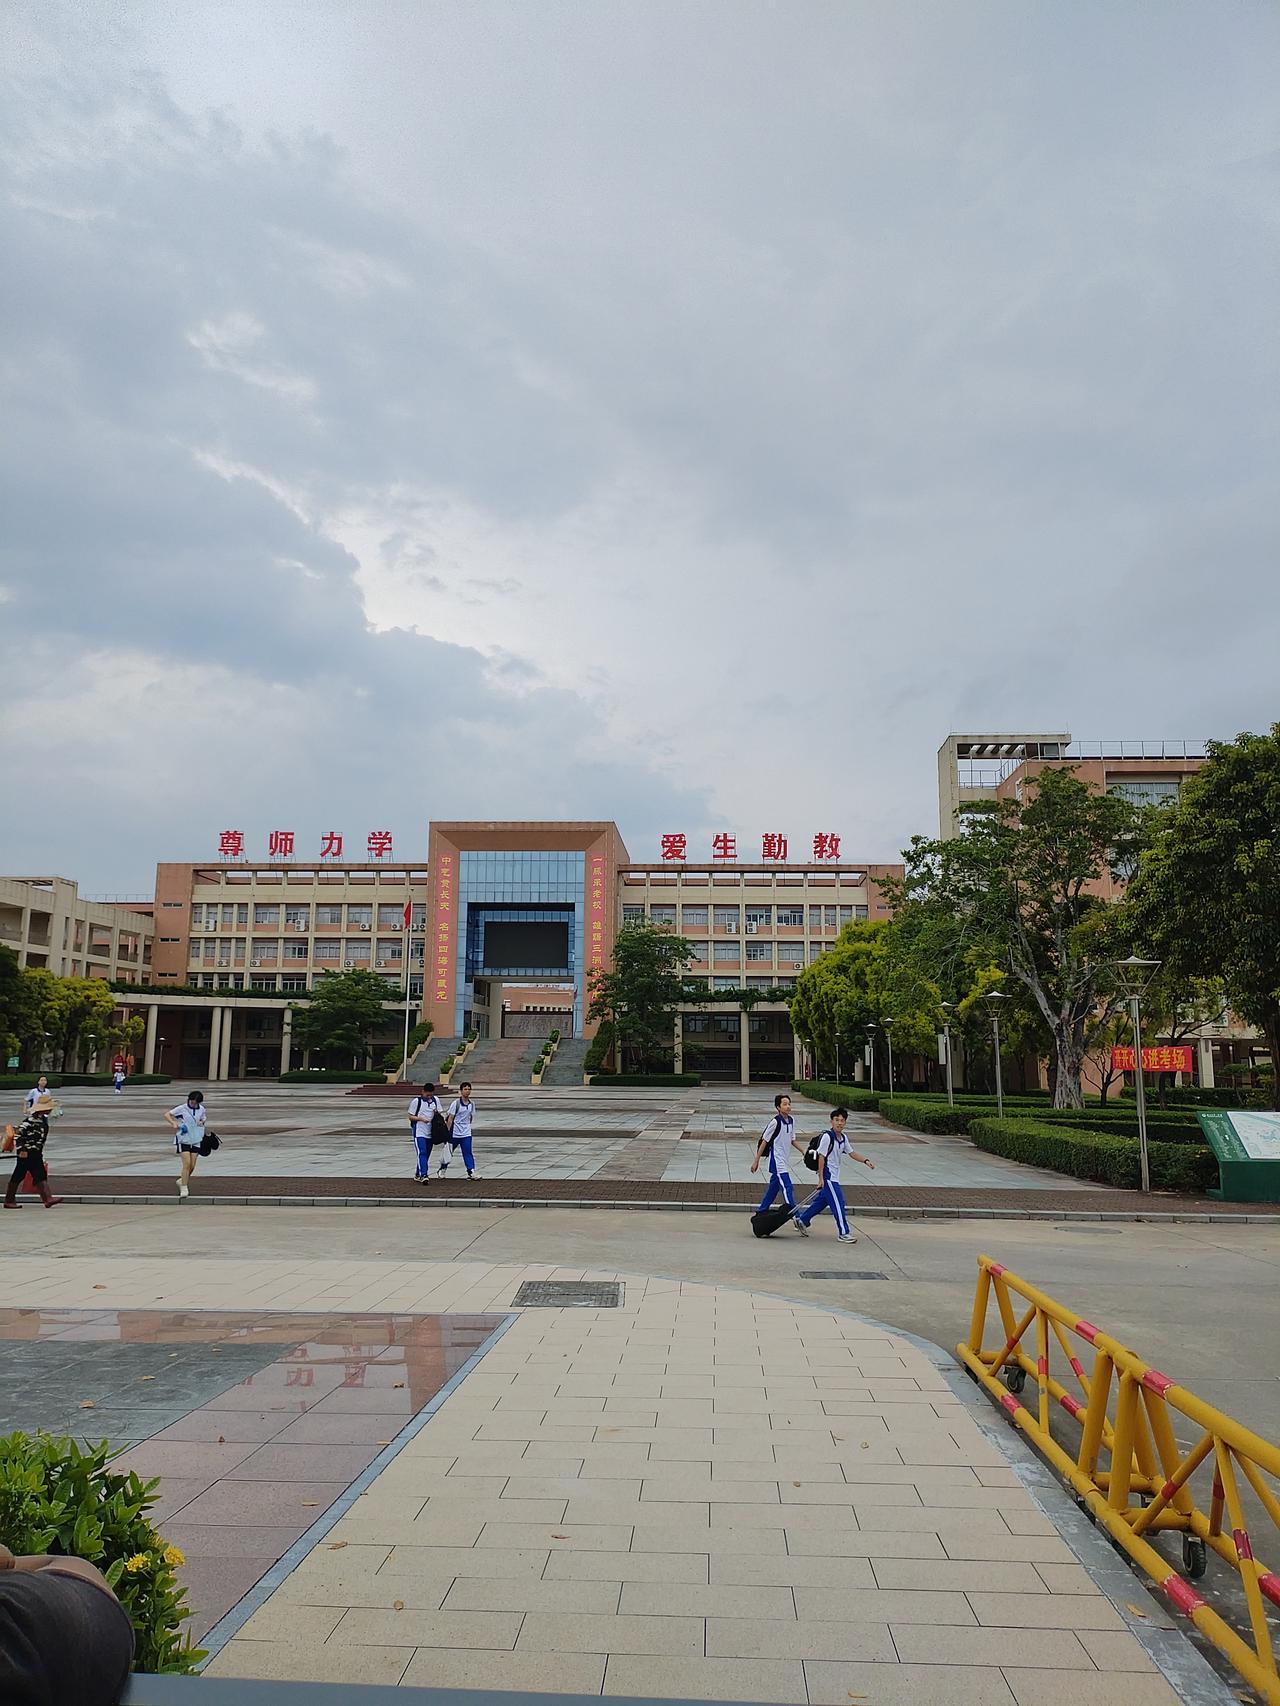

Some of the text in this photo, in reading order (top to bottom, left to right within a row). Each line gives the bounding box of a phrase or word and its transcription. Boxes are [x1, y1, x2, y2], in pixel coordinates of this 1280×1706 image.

[218, 831, 392, 857] 尊师力学
[661, 833, 841, 860] 爱生勤教
